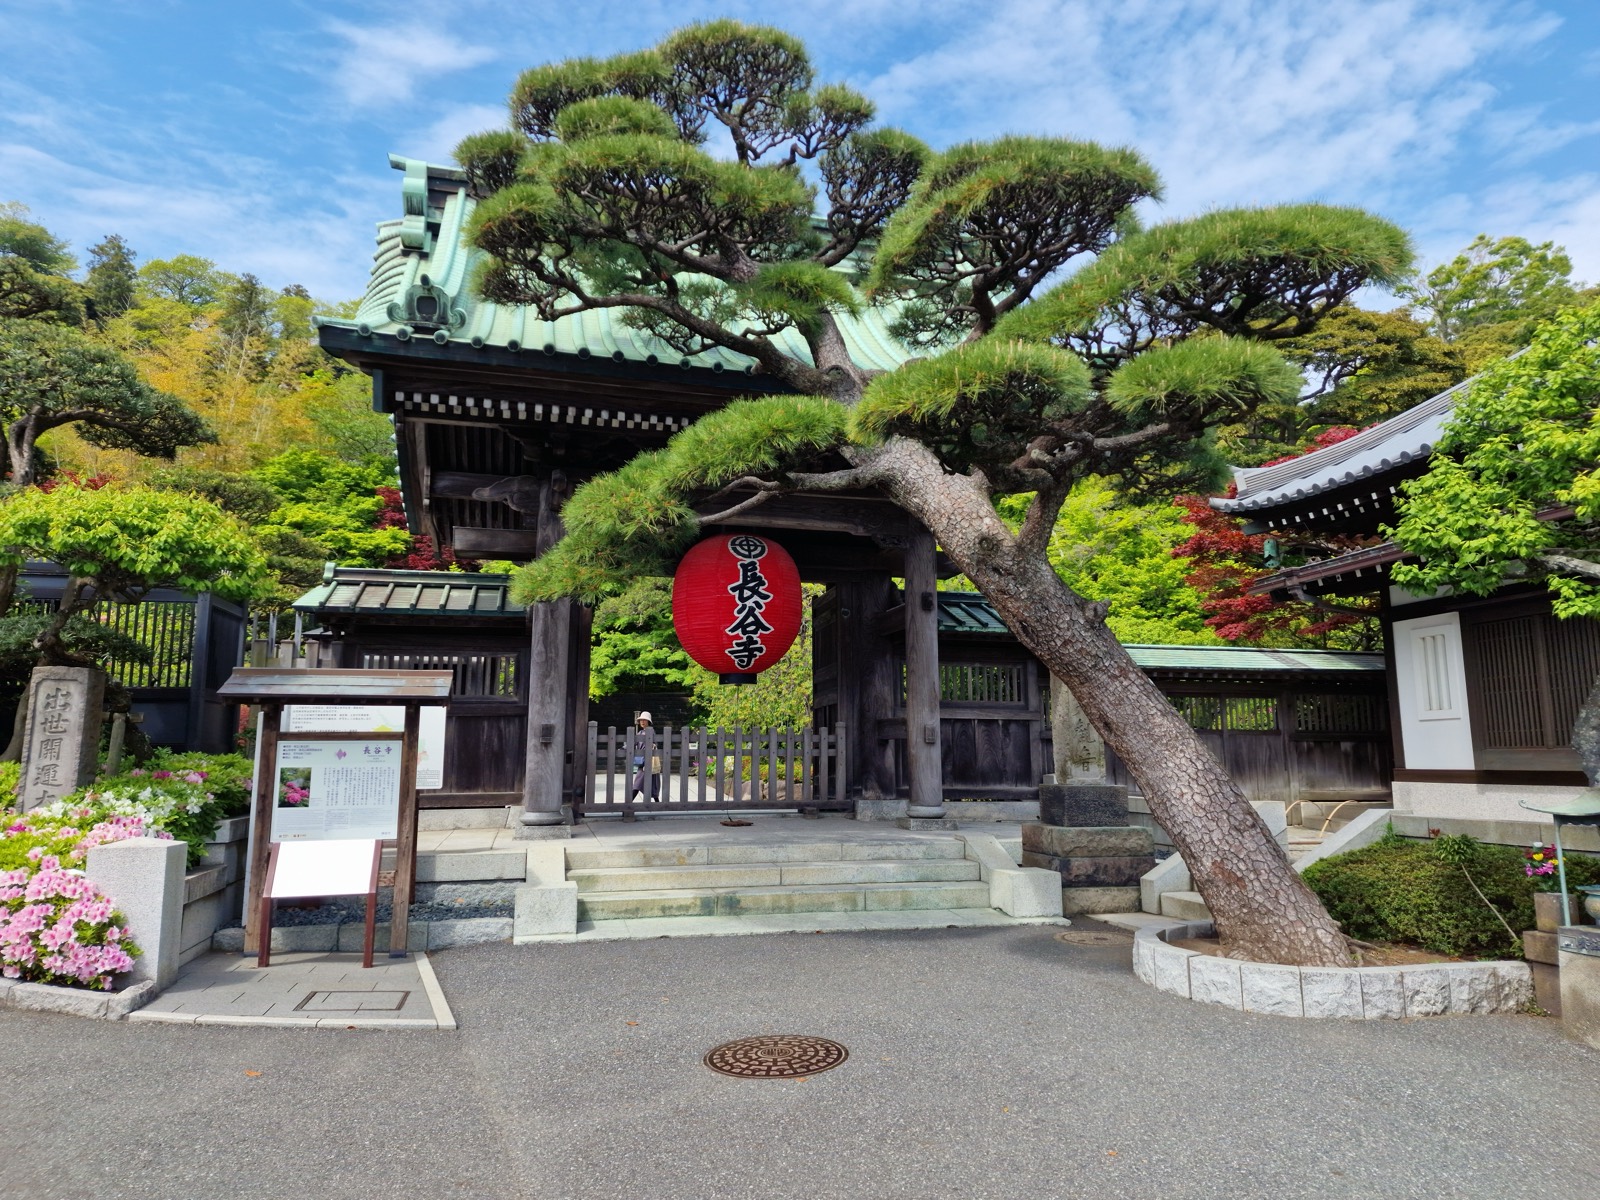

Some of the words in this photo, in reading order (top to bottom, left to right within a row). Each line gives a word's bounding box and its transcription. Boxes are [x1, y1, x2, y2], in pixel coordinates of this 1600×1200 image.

[726, 559, 774, 670] 長谷寺
[363, 746, 393, 755] 長谷寺
